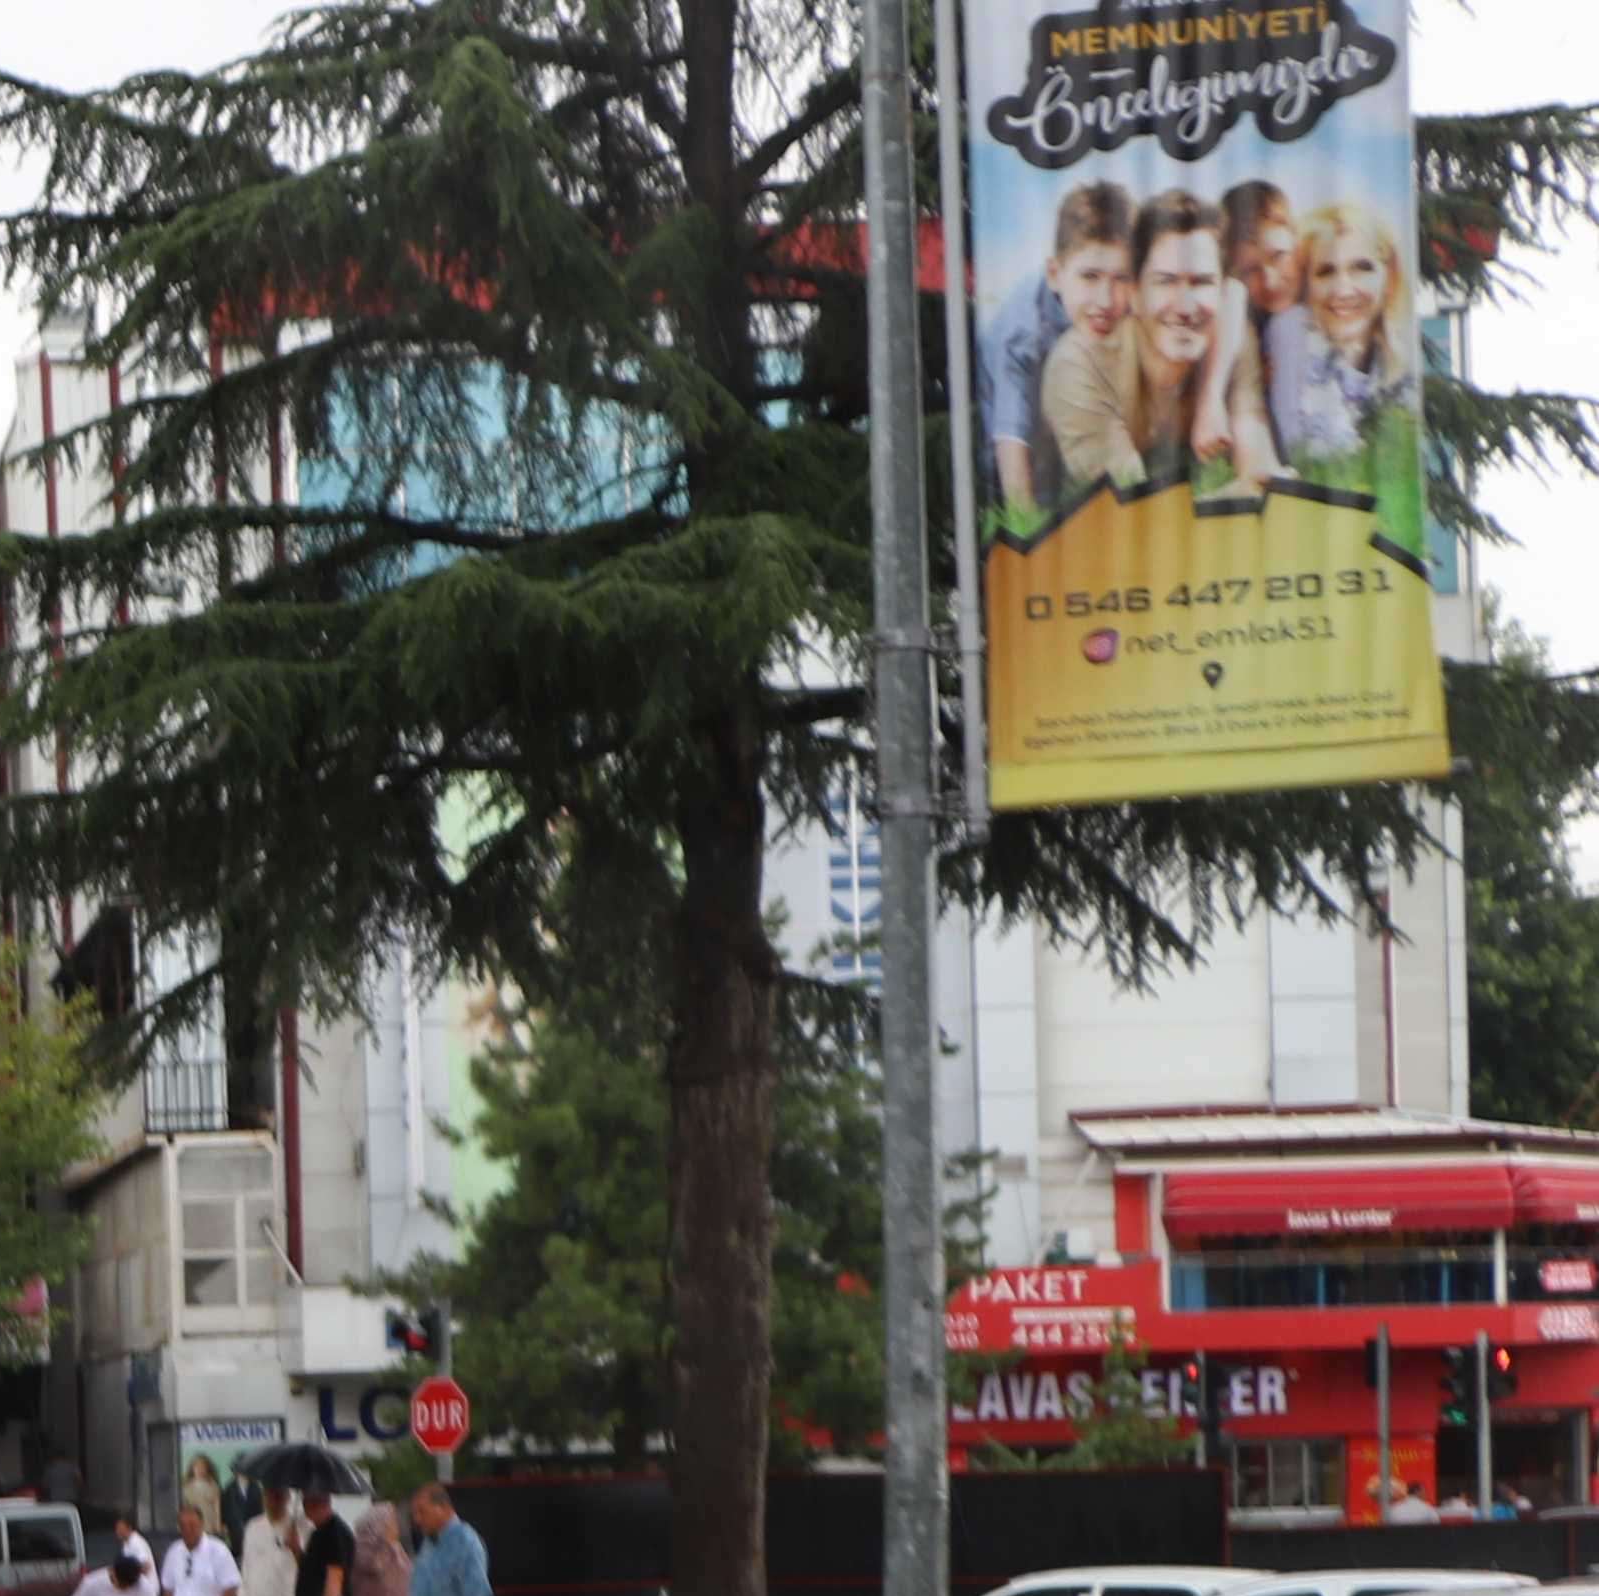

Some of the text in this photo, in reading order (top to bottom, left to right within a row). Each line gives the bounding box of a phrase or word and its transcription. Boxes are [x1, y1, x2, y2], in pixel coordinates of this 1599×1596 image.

[1049, 1, 1329, 58] MEMNUNİYETİ
[1166, 579, 1251, 608] 447
[1265, 573, 1323, 600] 20
[1337, 568, 1394, 596] 31
[969, 1270, 1089, 1303] PAKET
[416, 1401, 465, 1431] DUR
